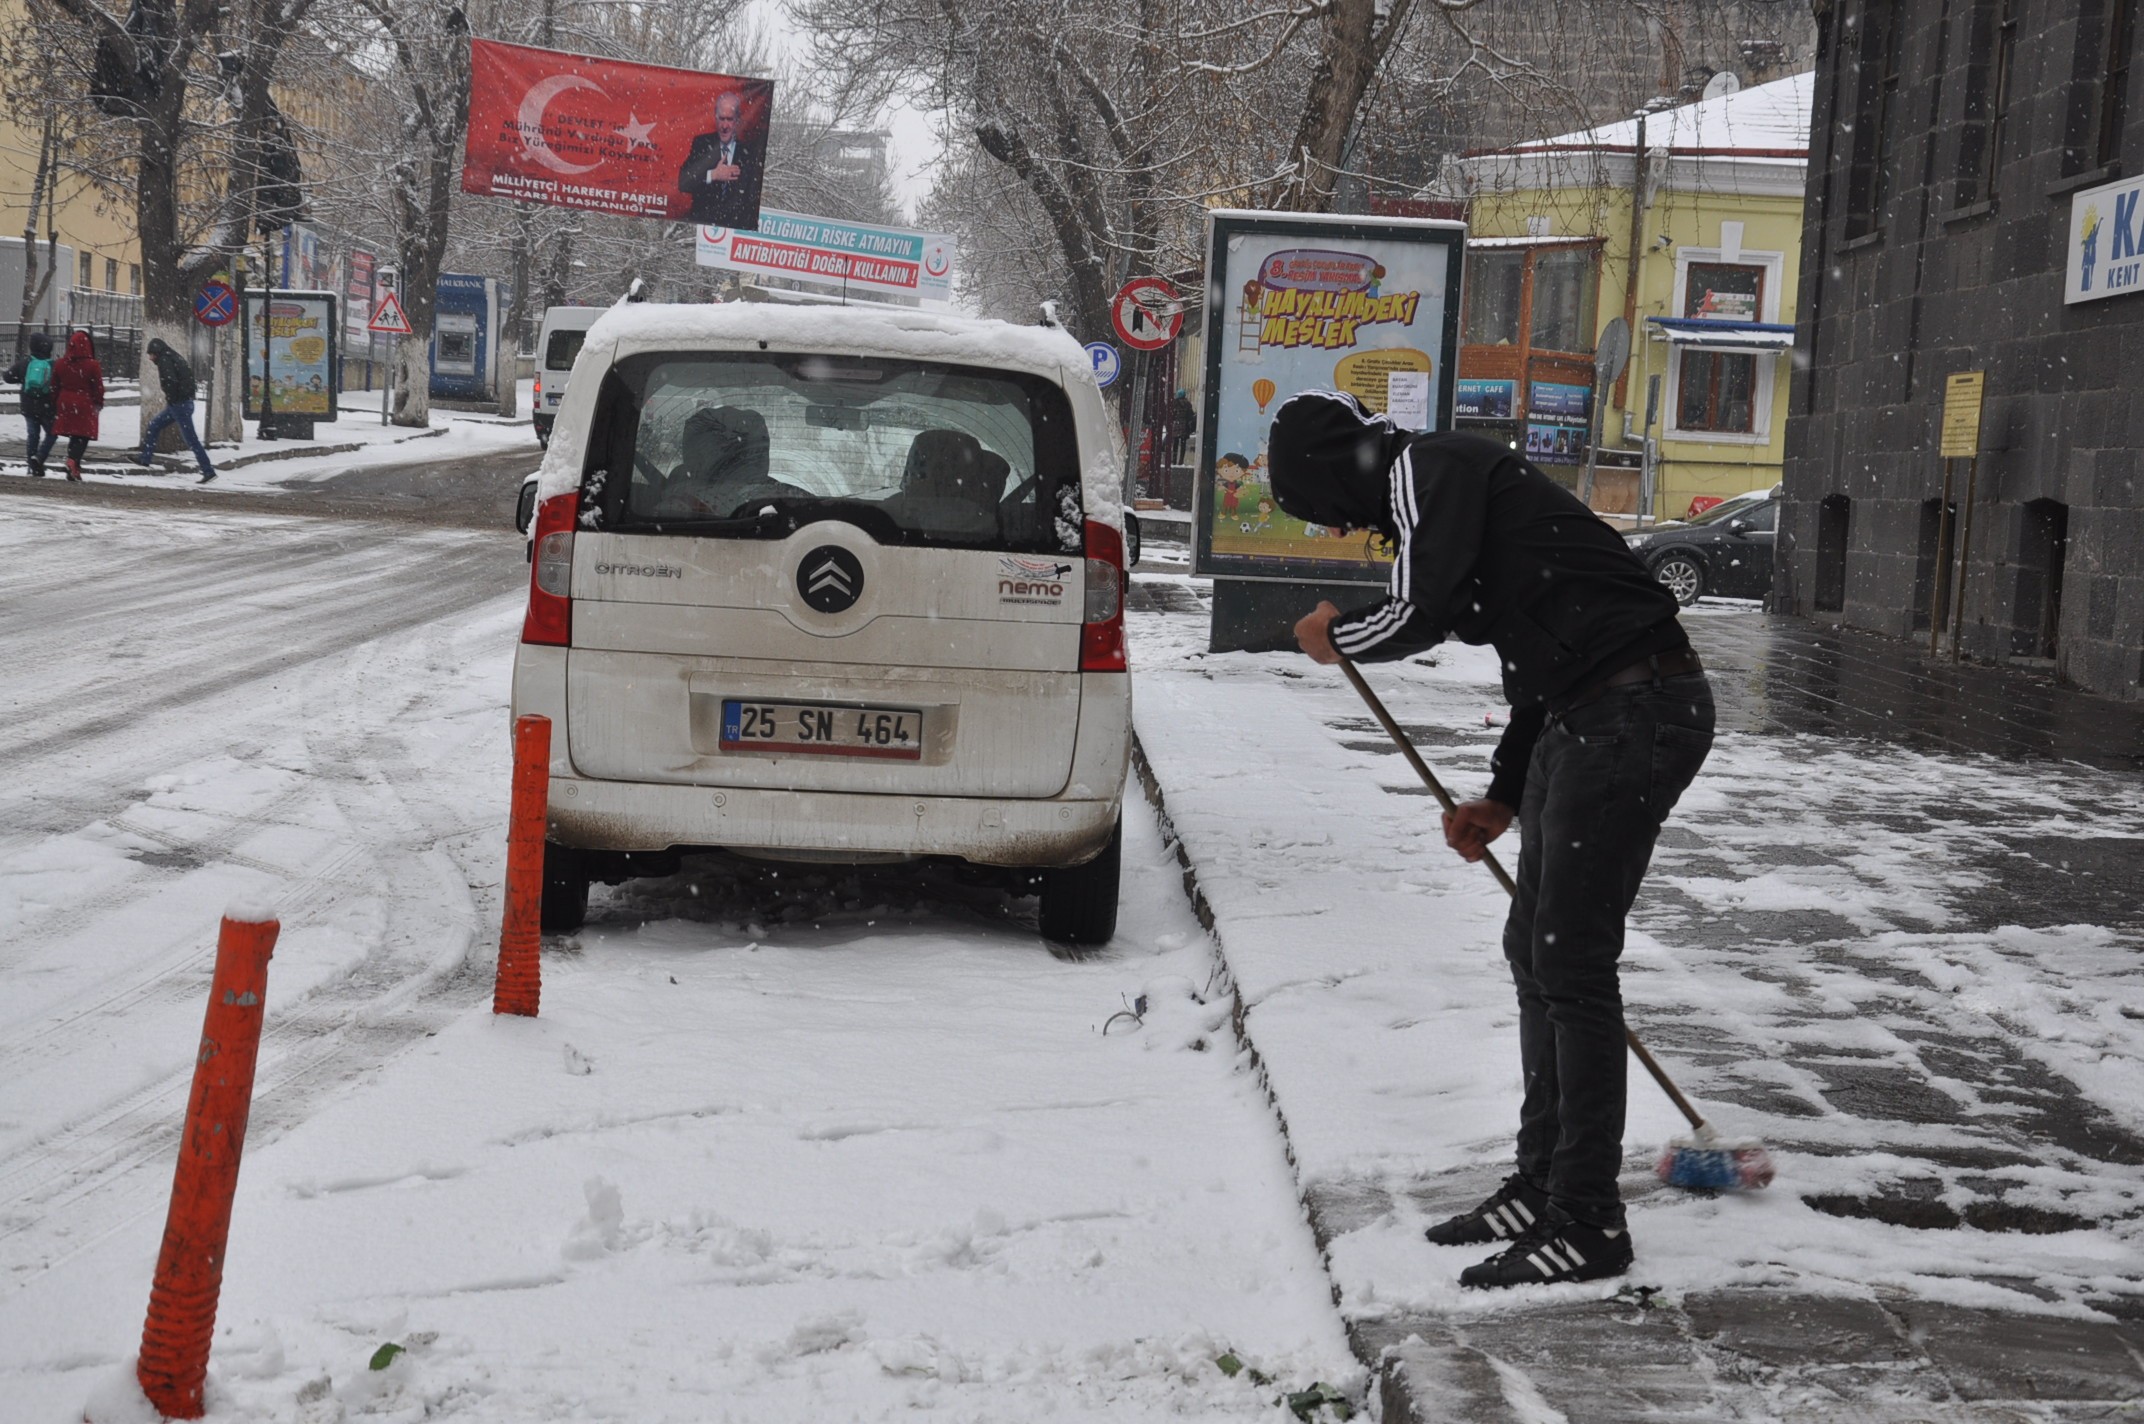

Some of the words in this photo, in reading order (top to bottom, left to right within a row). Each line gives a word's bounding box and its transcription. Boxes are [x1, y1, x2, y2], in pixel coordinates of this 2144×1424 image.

[502, 119, 562, 137] Mührünü
[558, 114, 604, 129] DEVLET
[499, 132, 519, 145] Biz
[525, 136, 595, 155] Yüreğimizi
[492, 173, 558, 193] MİLLİYETÇİ
[562, 184, 618, 200] HAREKET
[621, 191, 668, 207] PARTİSİ
[514, 189, 548, 200] KARS
[552, 192, 563, 203] İL
[567, 196, 643, 214] BAŞKANLIĞI
[757, 216, 818, 242] AĞLIĞINIZI
[821, 226, 857, 247] RİSKE
[858, 234, 913, 256] ATMAYIN
[734, 241, 811, 270] ANTİBİYOTİĞİ
[811, 253, 852, 274] DOĞRU
[853, 259, 910, 284] KULLANIN
[436, 278, 482, 289] HALKBANK
[2107, 263, 2140, 289] KENT
[1263, 287, 1420, 327] HAYALİMDEKİ
[1260, 317, 1359, 350] MESLEK
[1093, 349, 1108, 370] P
[1457, 385, 1481, 393] ERNET
[1485, 385, 1504, 393] CAFE
[594, 561, 682, 579] CITROËN
[998, 579, 1064, 597] nemo
[726, 724, 739, 735] TR
[741, 708, 776, 738] 25
[798, 710, 833, 741] SN
[857, 713, 909, 745] 464
